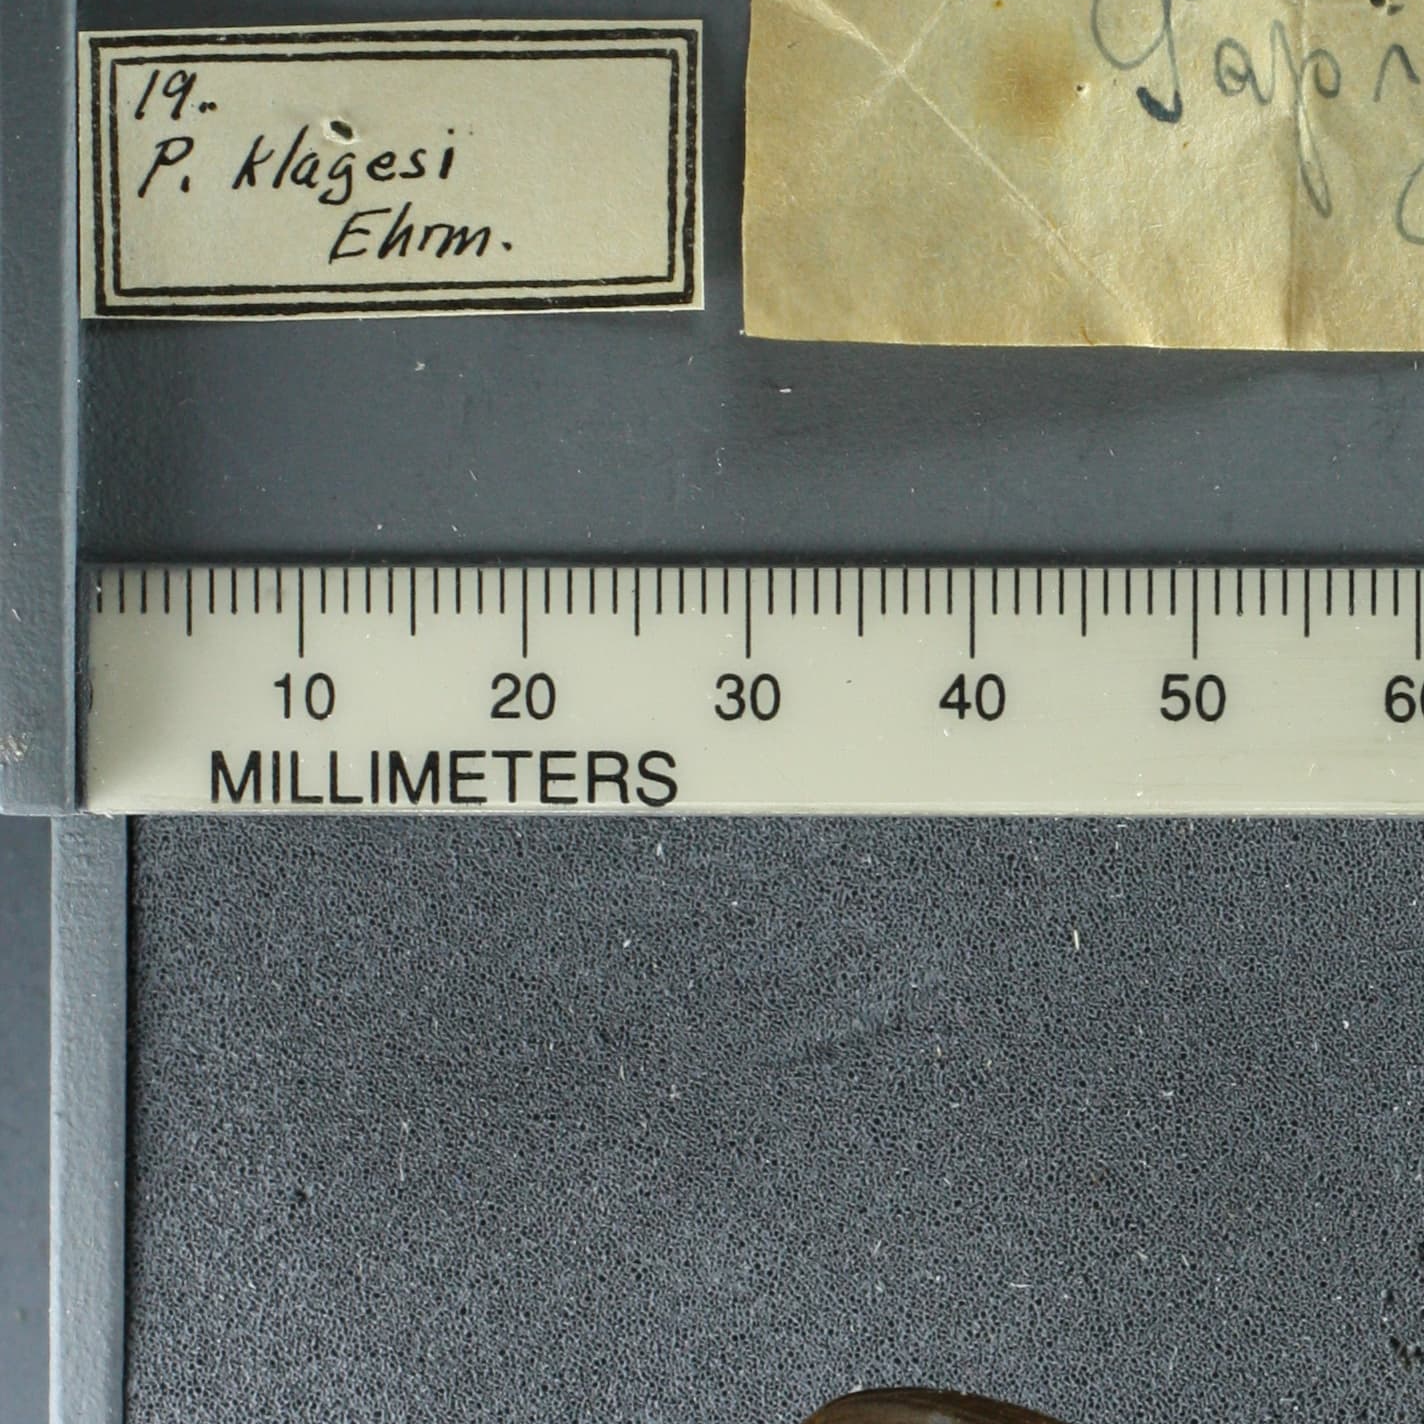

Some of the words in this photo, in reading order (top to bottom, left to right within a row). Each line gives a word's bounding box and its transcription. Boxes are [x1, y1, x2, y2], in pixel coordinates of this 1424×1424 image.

[137, 135, 195, 198] P.
[232, 125, 456, 206] klagesi
[328, 201, 513, 264] Ehrm.
[273, 672, 336, 721] 10
[490, 672, 556, 721] 20
[714, 672, 781, 722] 30
[938, 673, 1006, 722] 40
[1159, 673, 1227, 723] 50
[210, 749, 678, 805] MILLIMETERS
